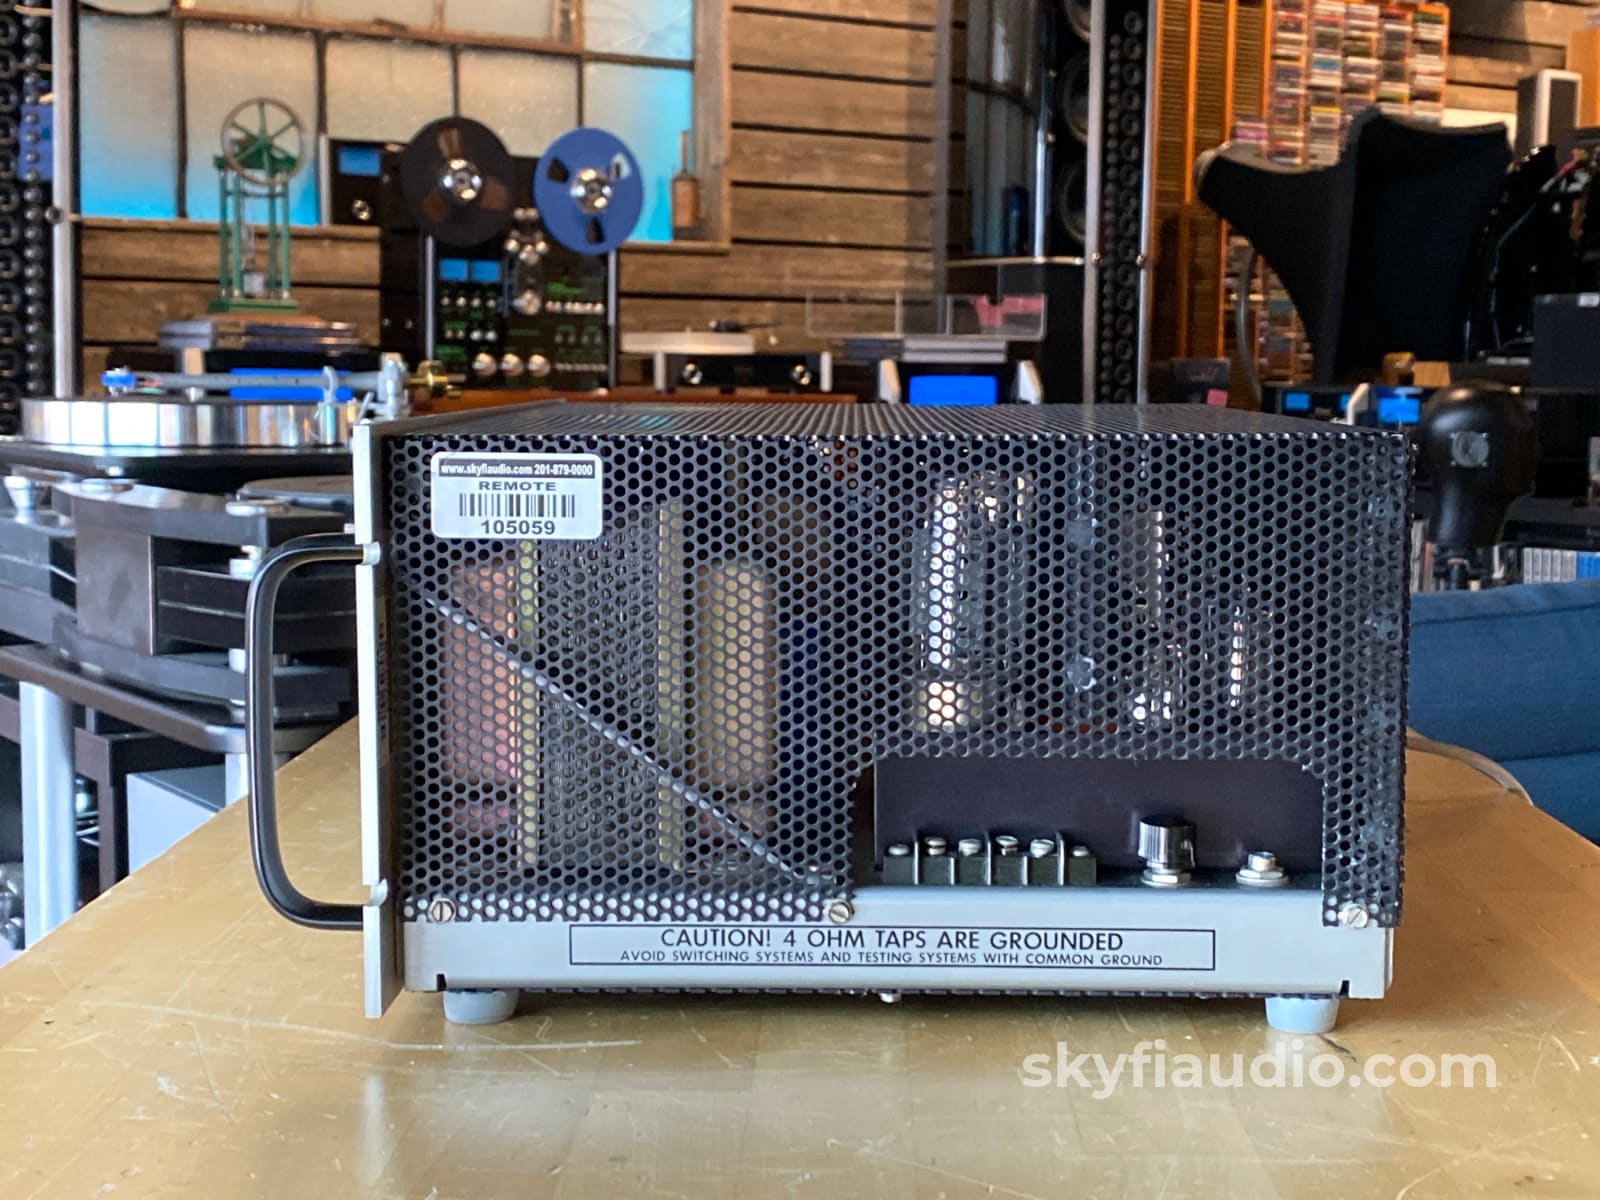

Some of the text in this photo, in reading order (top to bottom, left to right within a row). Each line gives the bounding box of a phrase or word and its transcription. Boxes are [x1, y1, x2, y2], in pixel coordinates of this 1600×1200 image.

[534, 464, 593, 475] 201-879-0000
[478, 481, 557, 491] REMOTE
[481, 520, 556, 535] 105059
[661, 929, 1124, 951] CAUTION! 4 OHM TAPS ARE GROUNDED
[620, 951, 1162, 966] AVOID SWITCHING SYSTEMS AND TESTING SYSTEMS WITH COMMON GROUND
